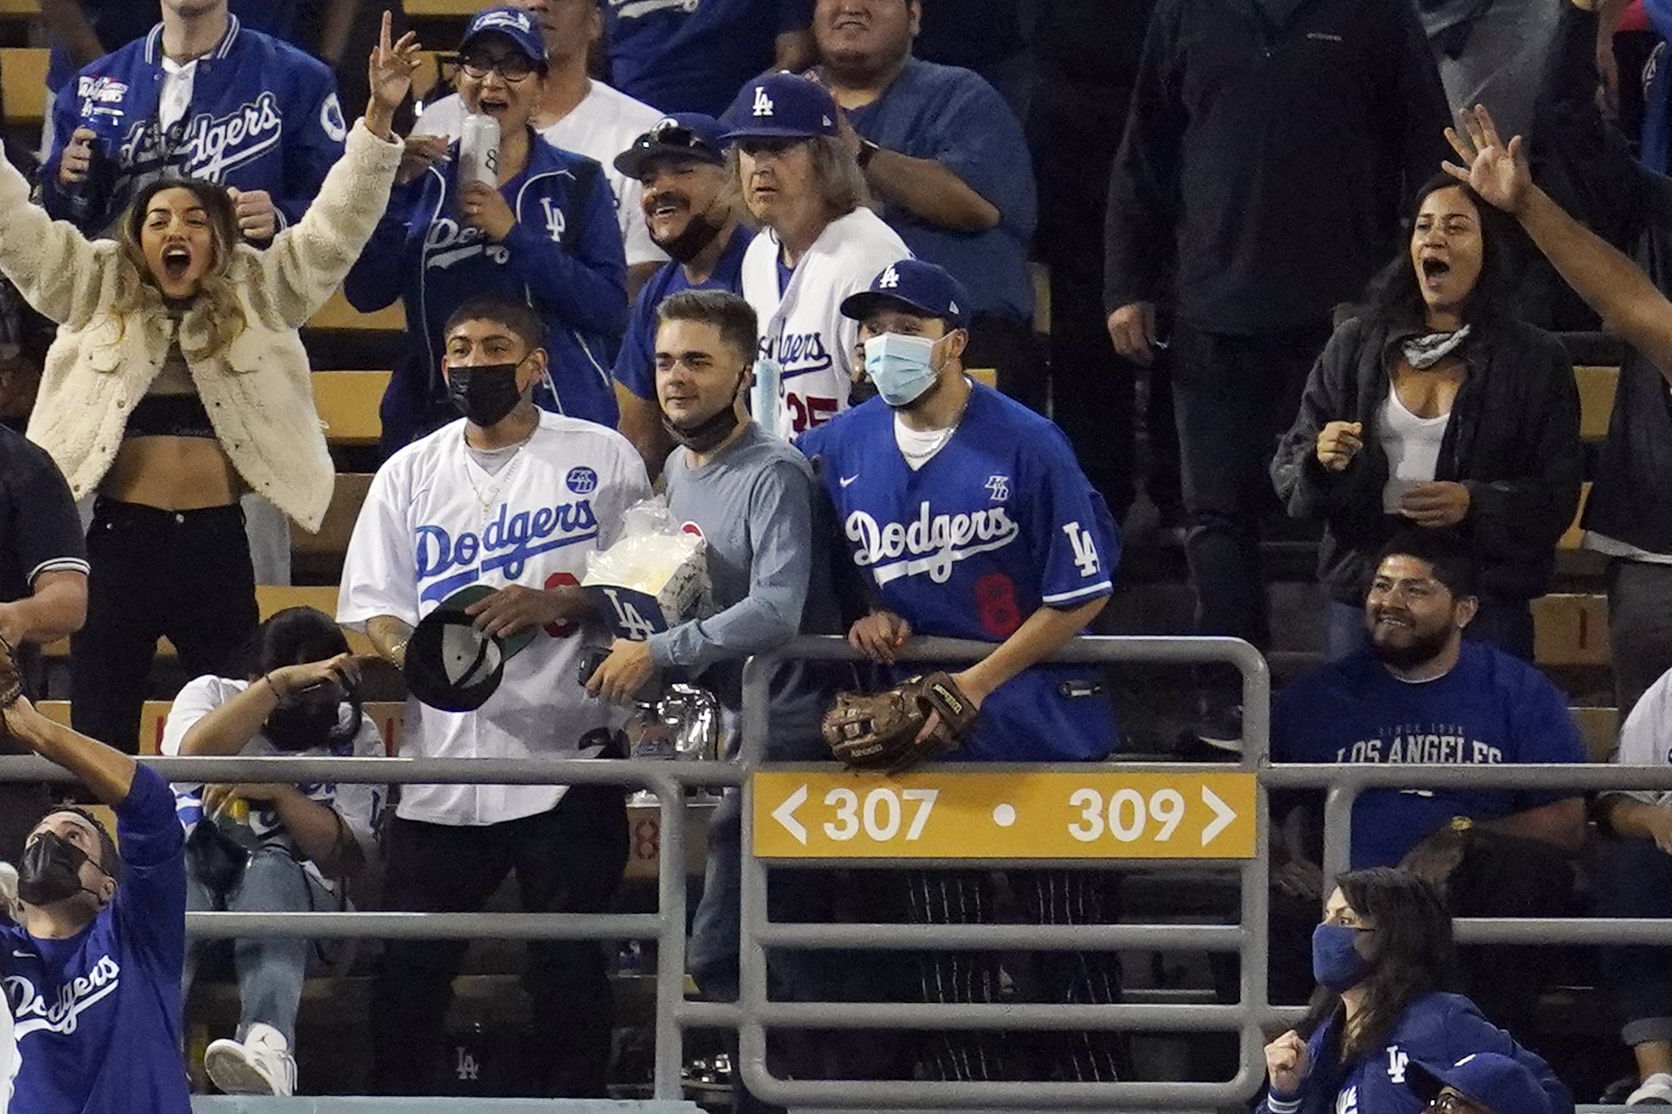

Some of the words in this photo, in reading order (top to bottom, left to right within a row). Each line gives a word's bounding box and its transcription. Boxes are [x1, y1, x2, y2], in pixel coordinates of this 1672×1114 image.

[752, 86, 773, 117] LA
[879, 265, 900, 288] LA
[415, 498, 600, 604] Dodgers
[845, 500, 1020, 588] Dodgers
[1063, 521, 1100, 578] LA
[602, 589, 655, 641] LA
[976, 572, 1021, 636] 8
[823, 787, 940, 842] 307
[1067, 788, 1185, 843] 309
[5, 953, 120, 1035] Dodgers
[456, 1047, 479, 1080] LA
